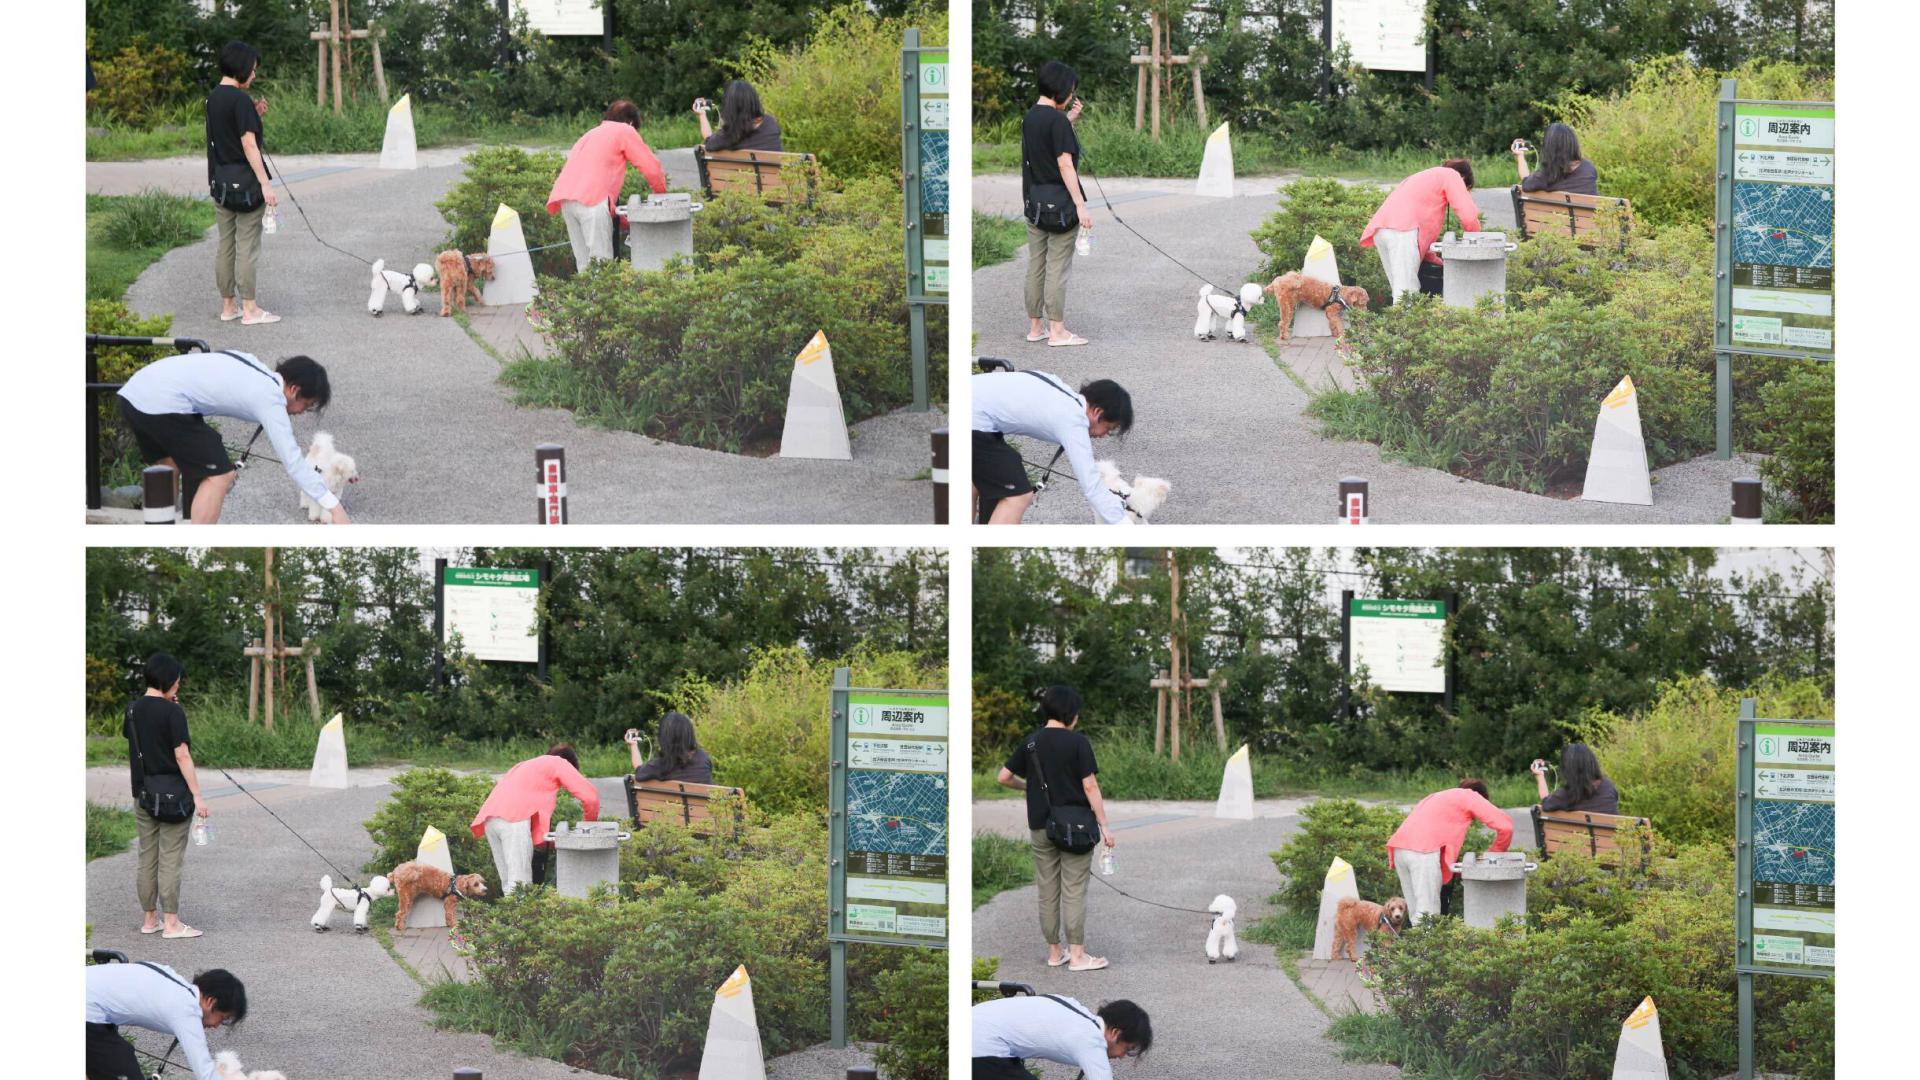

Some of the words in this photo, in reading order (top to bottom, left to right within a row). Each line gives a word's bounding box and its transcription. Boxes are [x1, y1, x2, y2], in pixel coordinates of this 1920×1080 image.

[1767, 122, 1811, 136] 周辺案内
[881, 710, 925, 724] 周辺案内
[1787, 741, 1831, 754] 周辺案内
